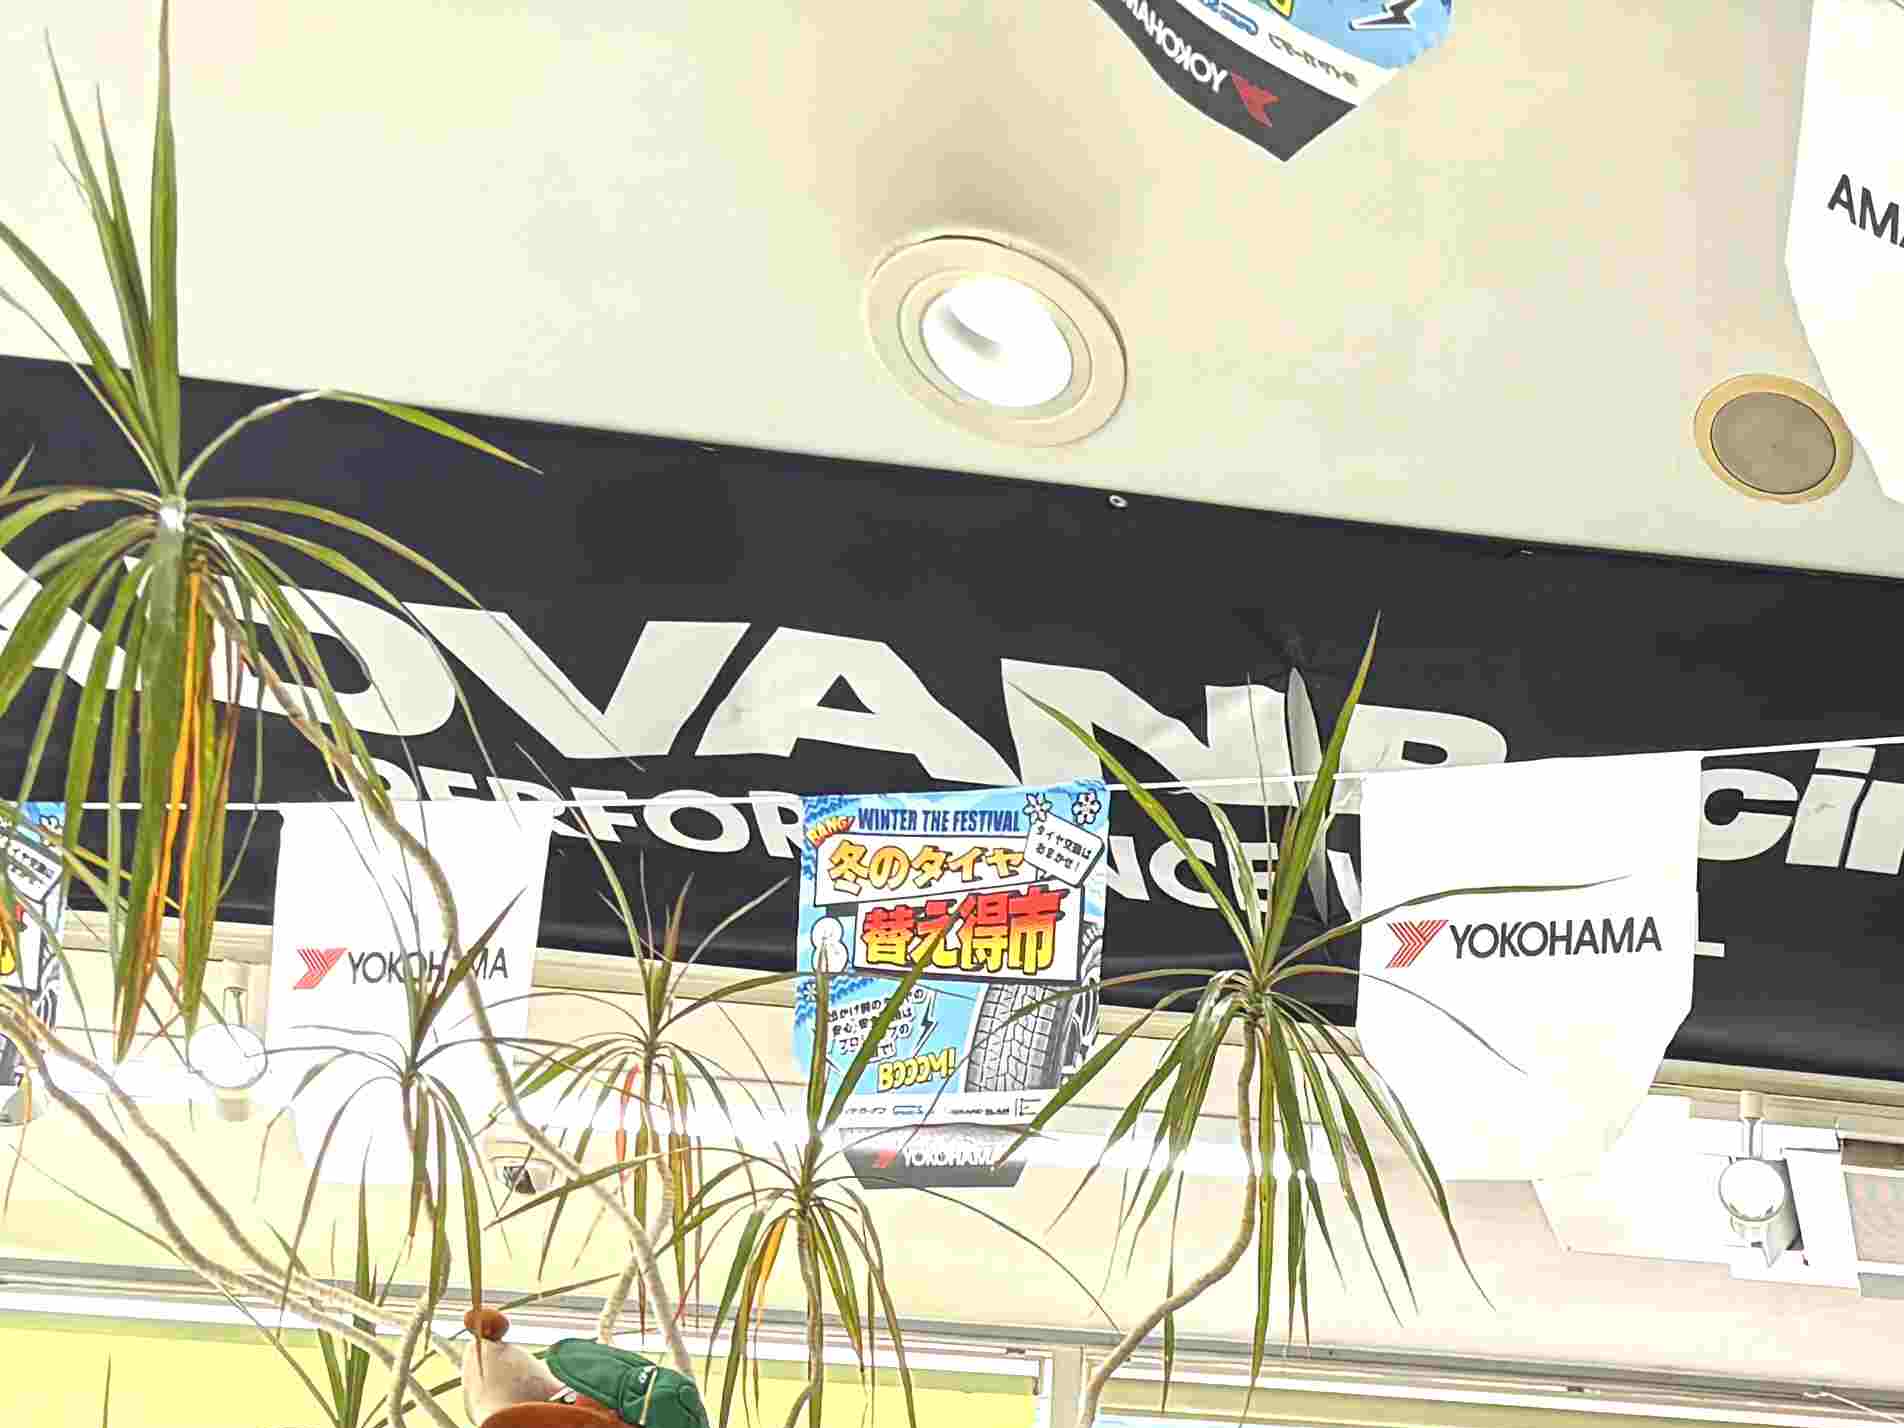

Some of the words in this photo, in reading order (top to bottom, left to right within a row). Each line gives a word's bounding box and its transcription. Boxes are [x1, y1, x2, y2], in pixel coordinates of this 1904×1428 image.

[857, 807, 918, 832] WINTER
[921, 809, 950, 833] THE
[952, 809, 1021, 833] FESTIVAL
[829, 839, 1025, 896] 冬のタイヤ
[861, 885, 1069, 974] 替え得市
[1450, 915, 1663, 961] YOKOHAMA
[347, 945, 509, 986] YOKOHMA
[878, 1049, 958, 1092] BOOOM!
